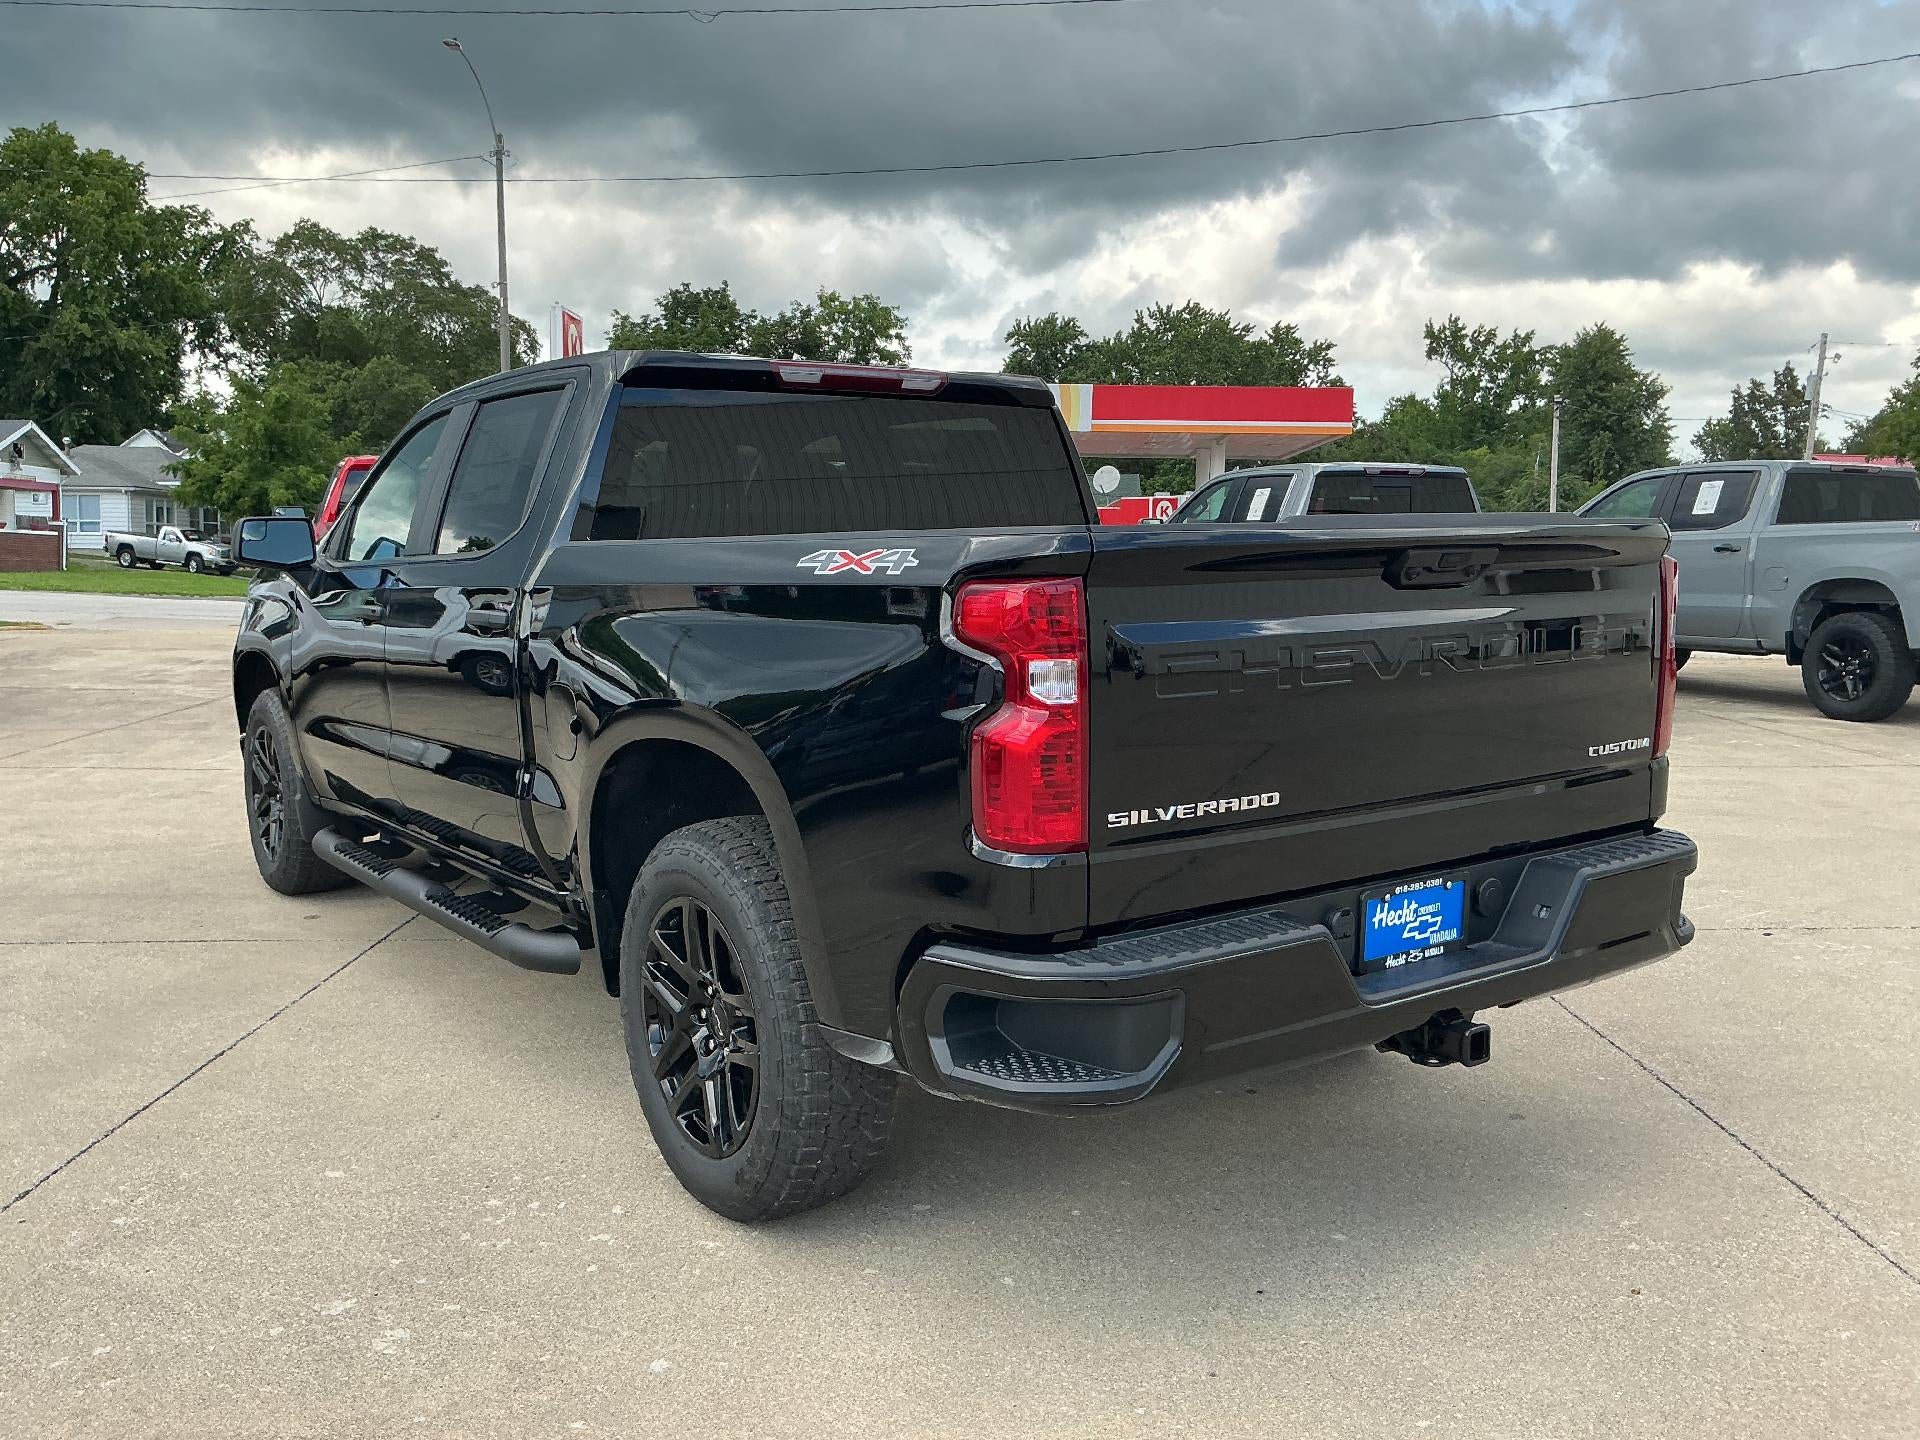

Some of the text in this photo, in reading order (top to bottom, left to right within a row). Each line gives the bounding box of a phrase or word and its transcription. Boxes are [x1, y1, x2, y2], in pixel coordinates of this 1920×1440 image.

[1160, 505, 1170, 518] K
[1156, 619, 1647, 698] CHEVROLET
[1588, 737, 1650, 757] CUSTOM
[1107, 791, 1281, 828] SILVERADO
[1372, 898, 1418, 929] Hecht
[1385, 953, 1406, 968] Hecht
